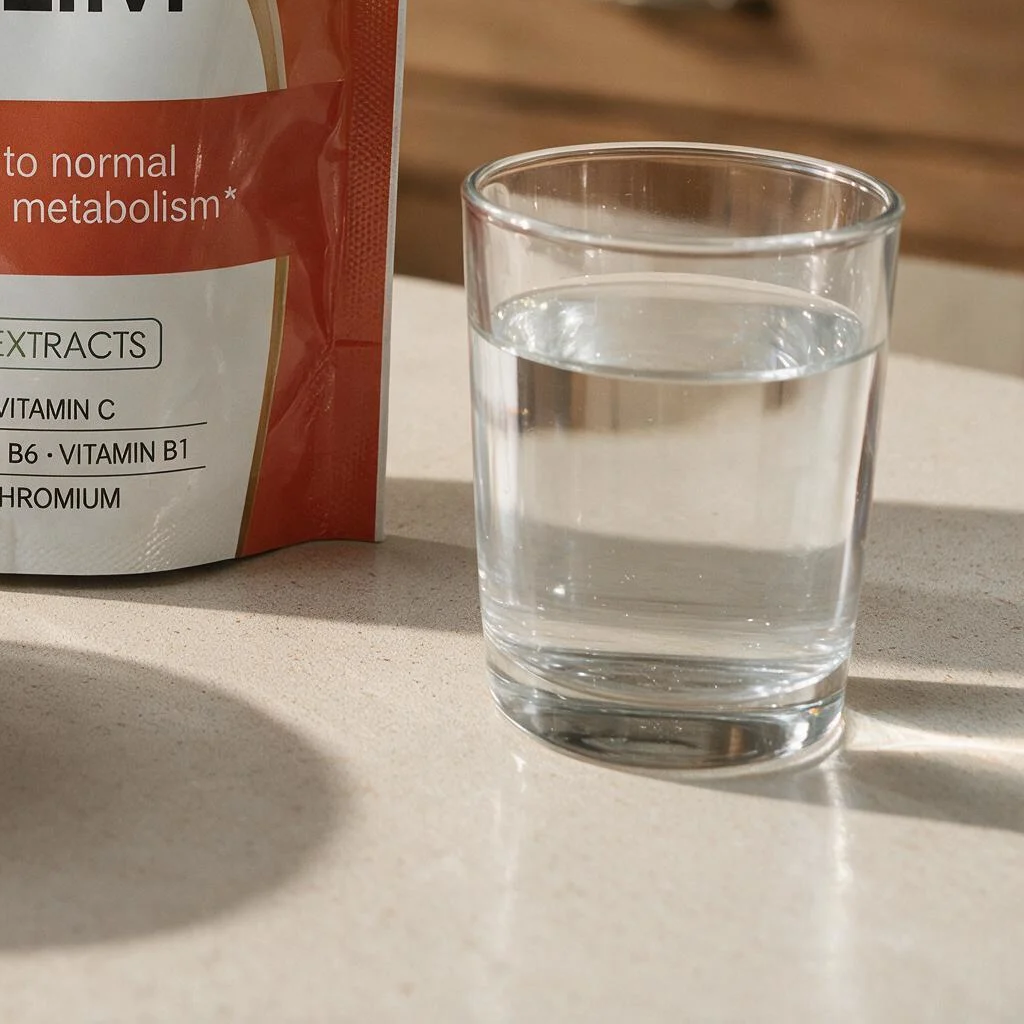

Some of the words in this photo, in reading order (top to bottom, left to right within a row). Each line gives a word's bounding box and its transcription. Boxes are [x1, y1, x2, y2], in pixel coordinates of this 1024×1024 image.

[3, 146, 38, 178] to
[52, 143, 176, 178] normal
[98, 399, 115, 420] C
[8, 442, 38, 465] B6
[59, 441, 155, 465] VITAMIN
[163, 438, 188, 461] B1
